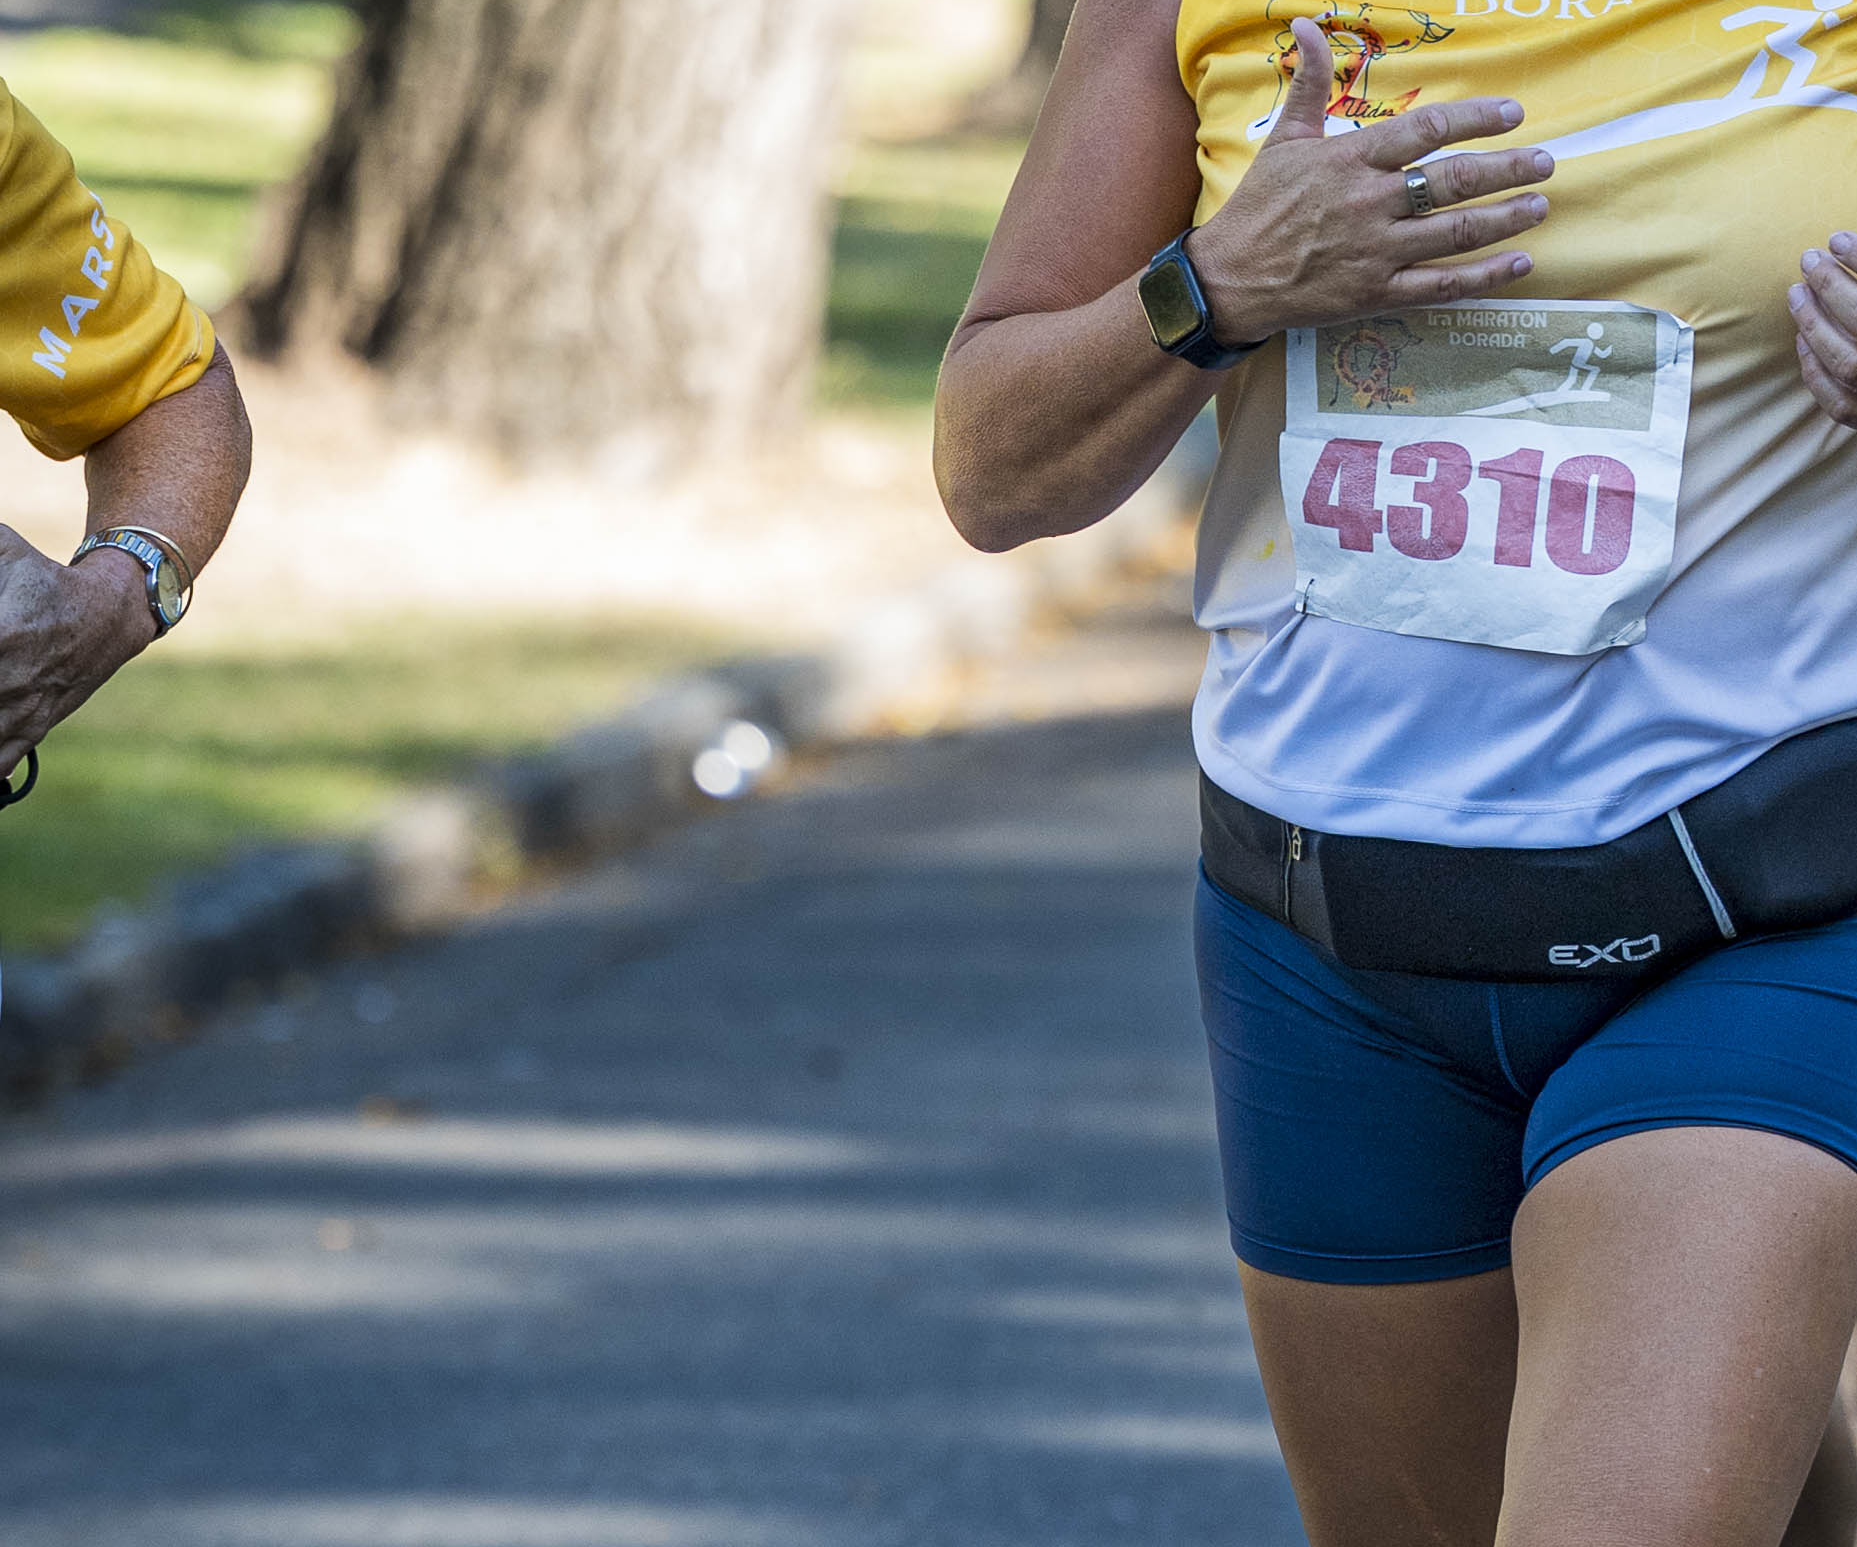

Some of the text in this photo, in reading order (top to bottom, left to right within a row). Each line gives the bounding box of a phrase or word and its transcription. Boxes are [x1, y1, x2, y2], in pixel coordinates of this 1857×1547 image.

[1449, 332, 1526, 348] DORADA
[1302, 437, 1636, 576] 4310
[1548, 933, 1660, 968] EXO
